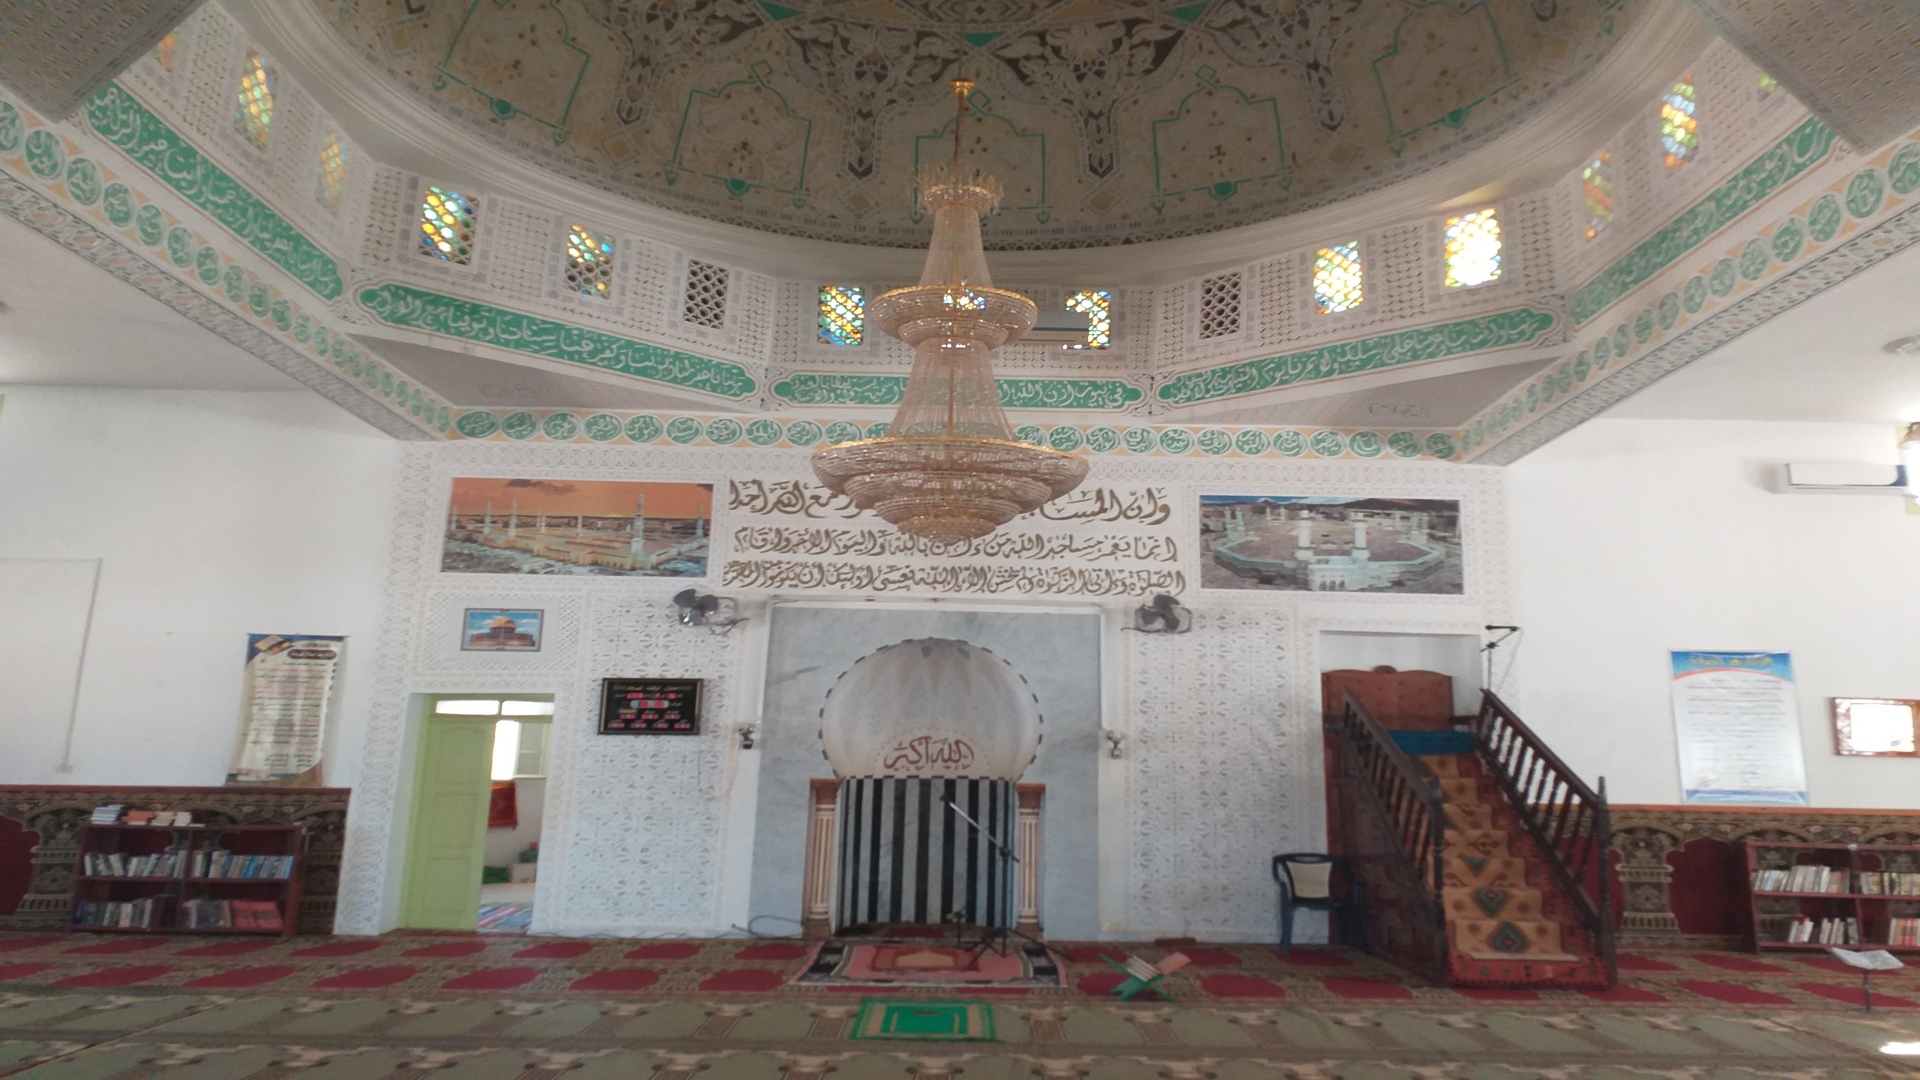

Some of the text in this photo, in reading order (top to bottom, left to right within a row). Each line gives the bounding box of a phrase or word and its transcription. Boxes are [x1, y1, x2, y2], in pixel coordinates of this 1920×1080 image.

[761, 480, 805, 515] الله
[888, 530, 929, 557] بالله
[983, 532, 1013, 557] من
[1003, 532, 1046, 559] الله
[1035, 533, 1105, 560] مساجد
[1086, 535, 1132, 562] يعمر
[913, 567, 959, 592] الله
[931, 738, 975, 771] الله
